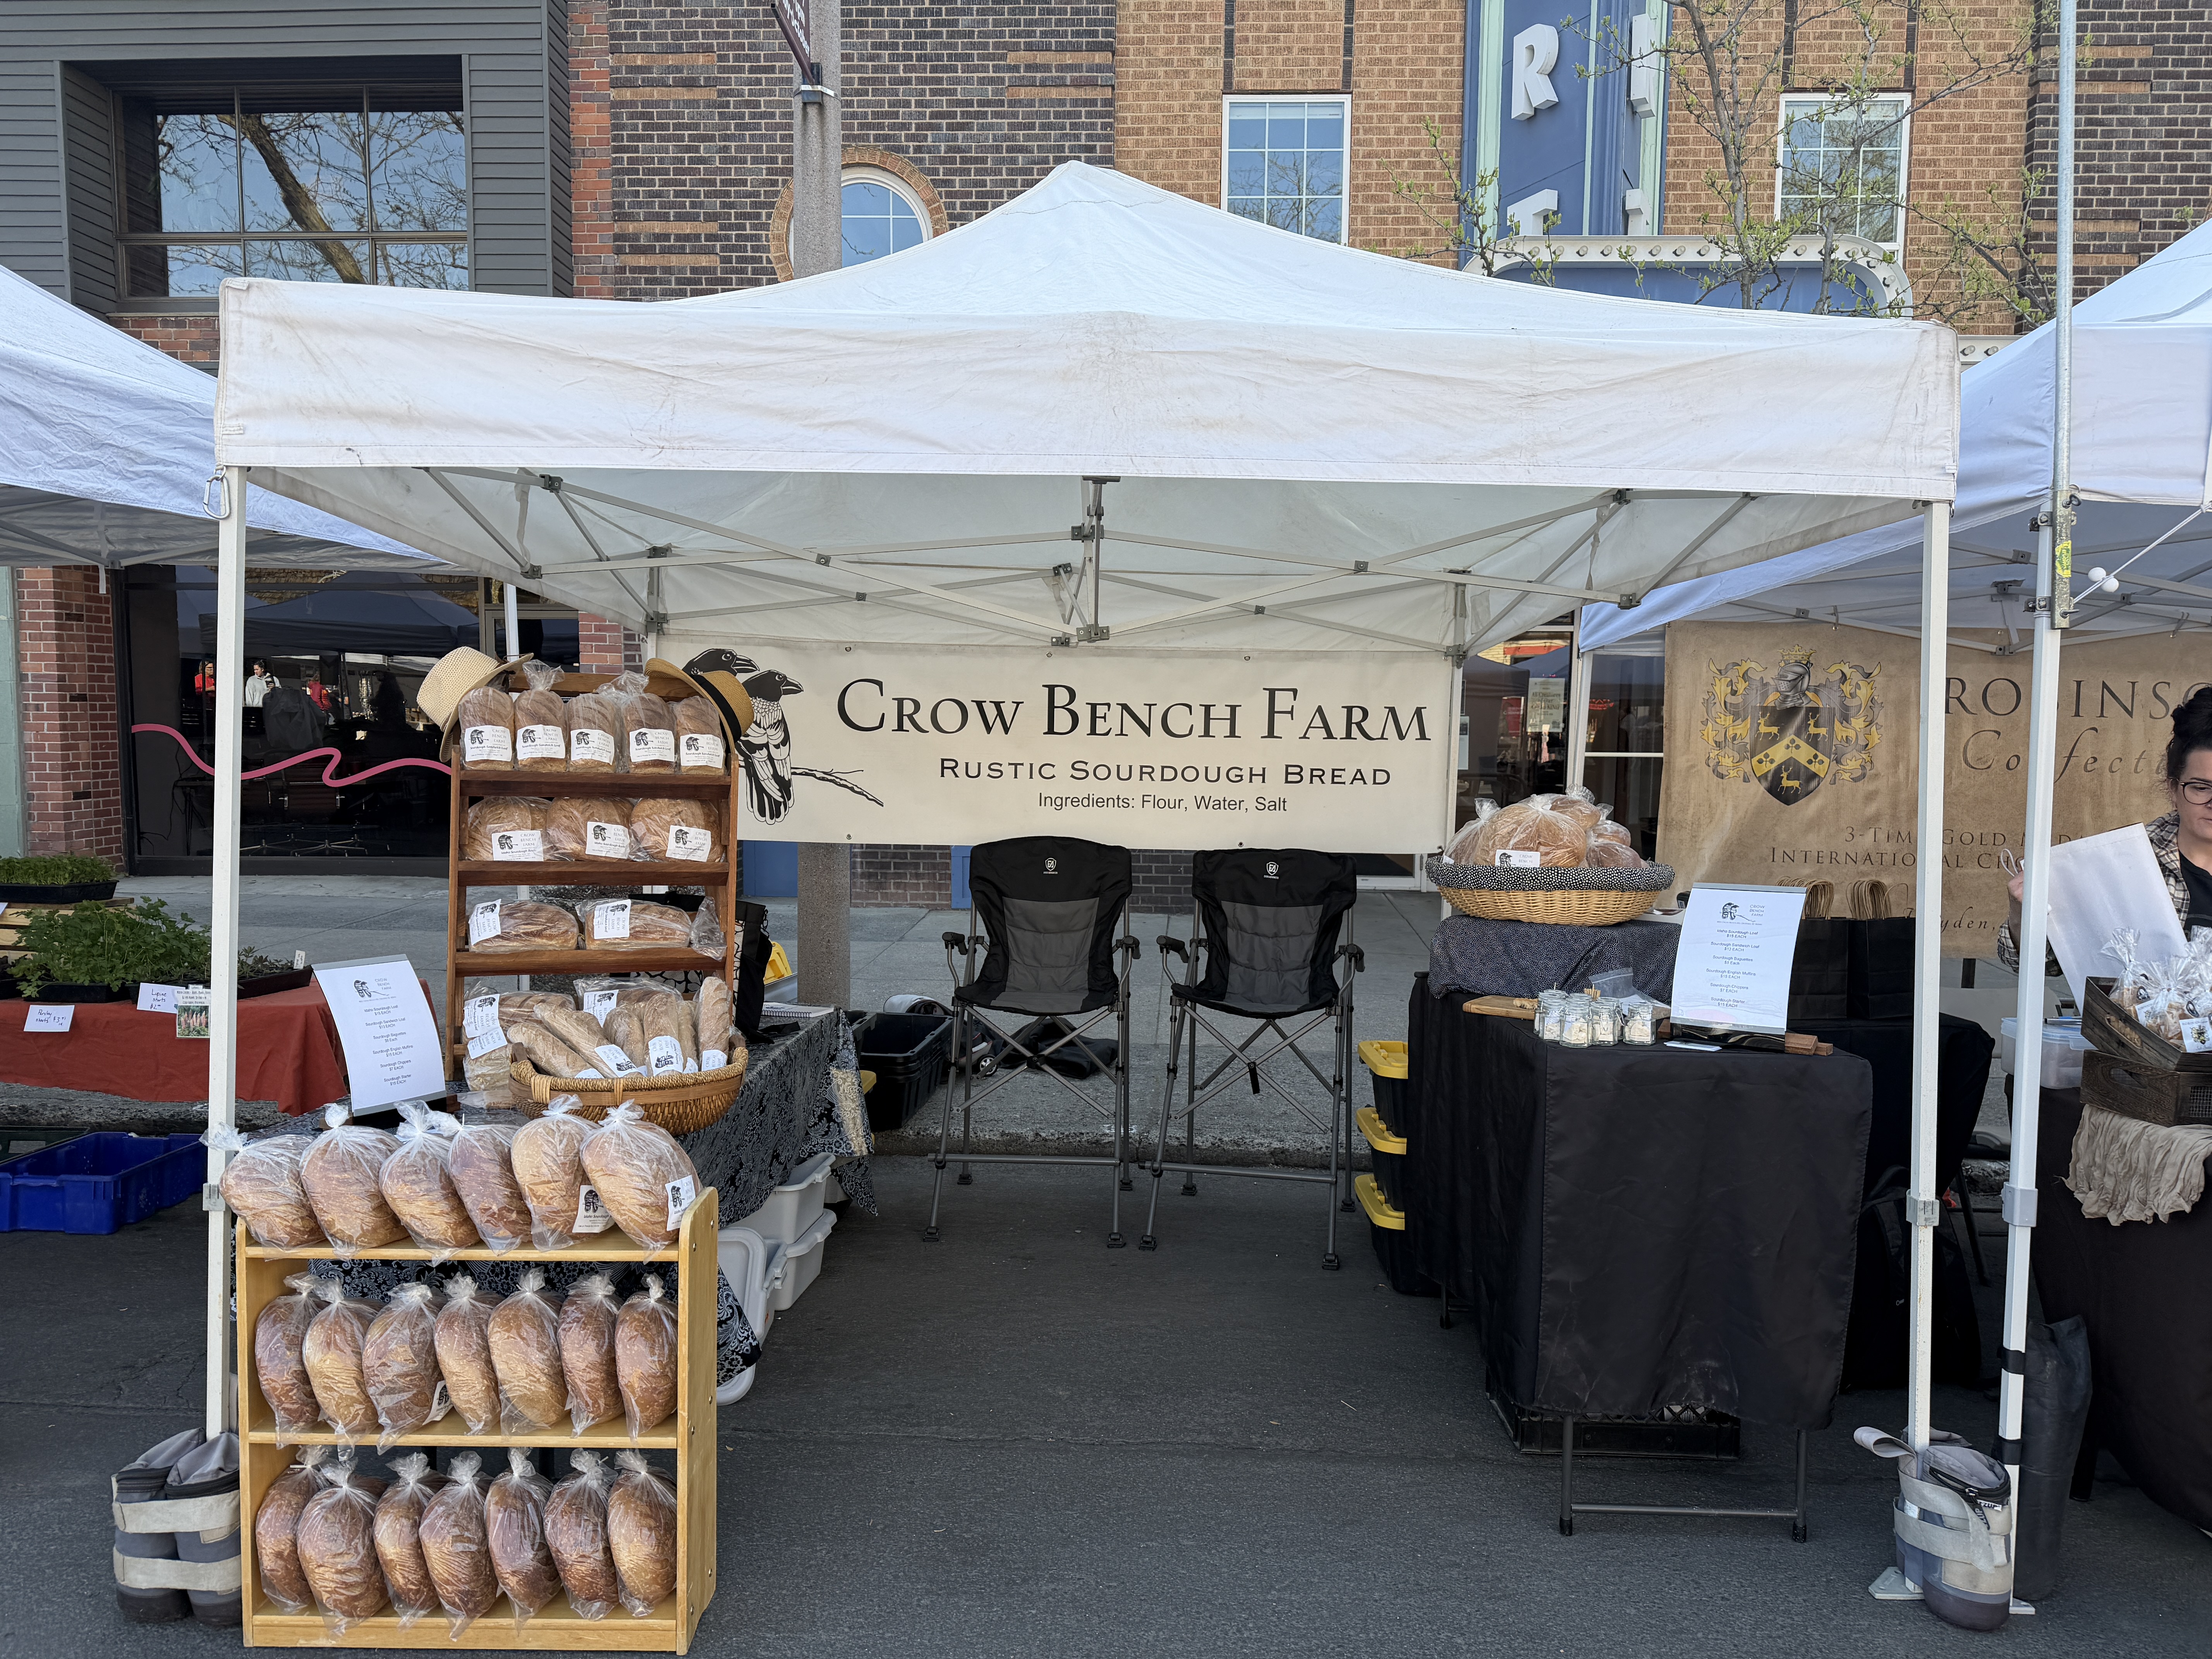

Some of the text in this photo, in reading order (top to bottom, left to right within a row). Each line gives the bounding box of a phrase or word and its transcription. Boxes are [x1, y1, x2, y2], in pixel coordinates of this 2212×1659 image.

[782, 0, 809, 57] ay-October
[837, 678, 1431, 741] CROW BENCH FARM
[1945, 677, 2211, 720] ROINS
[940, 758, 1390, 785] RUSTIC SOURDOUGH BREAD
[1039, 792, 1287, 813] Ingredients: Flour, Water, Salt
[1845, 826, 1912, 843] 3-TIM
[1942, 829, 2006, 847] GOLD
[1771, 847, 1964, 869] INTERNATIOAL
[152, 988, 167, 998] Lupine
